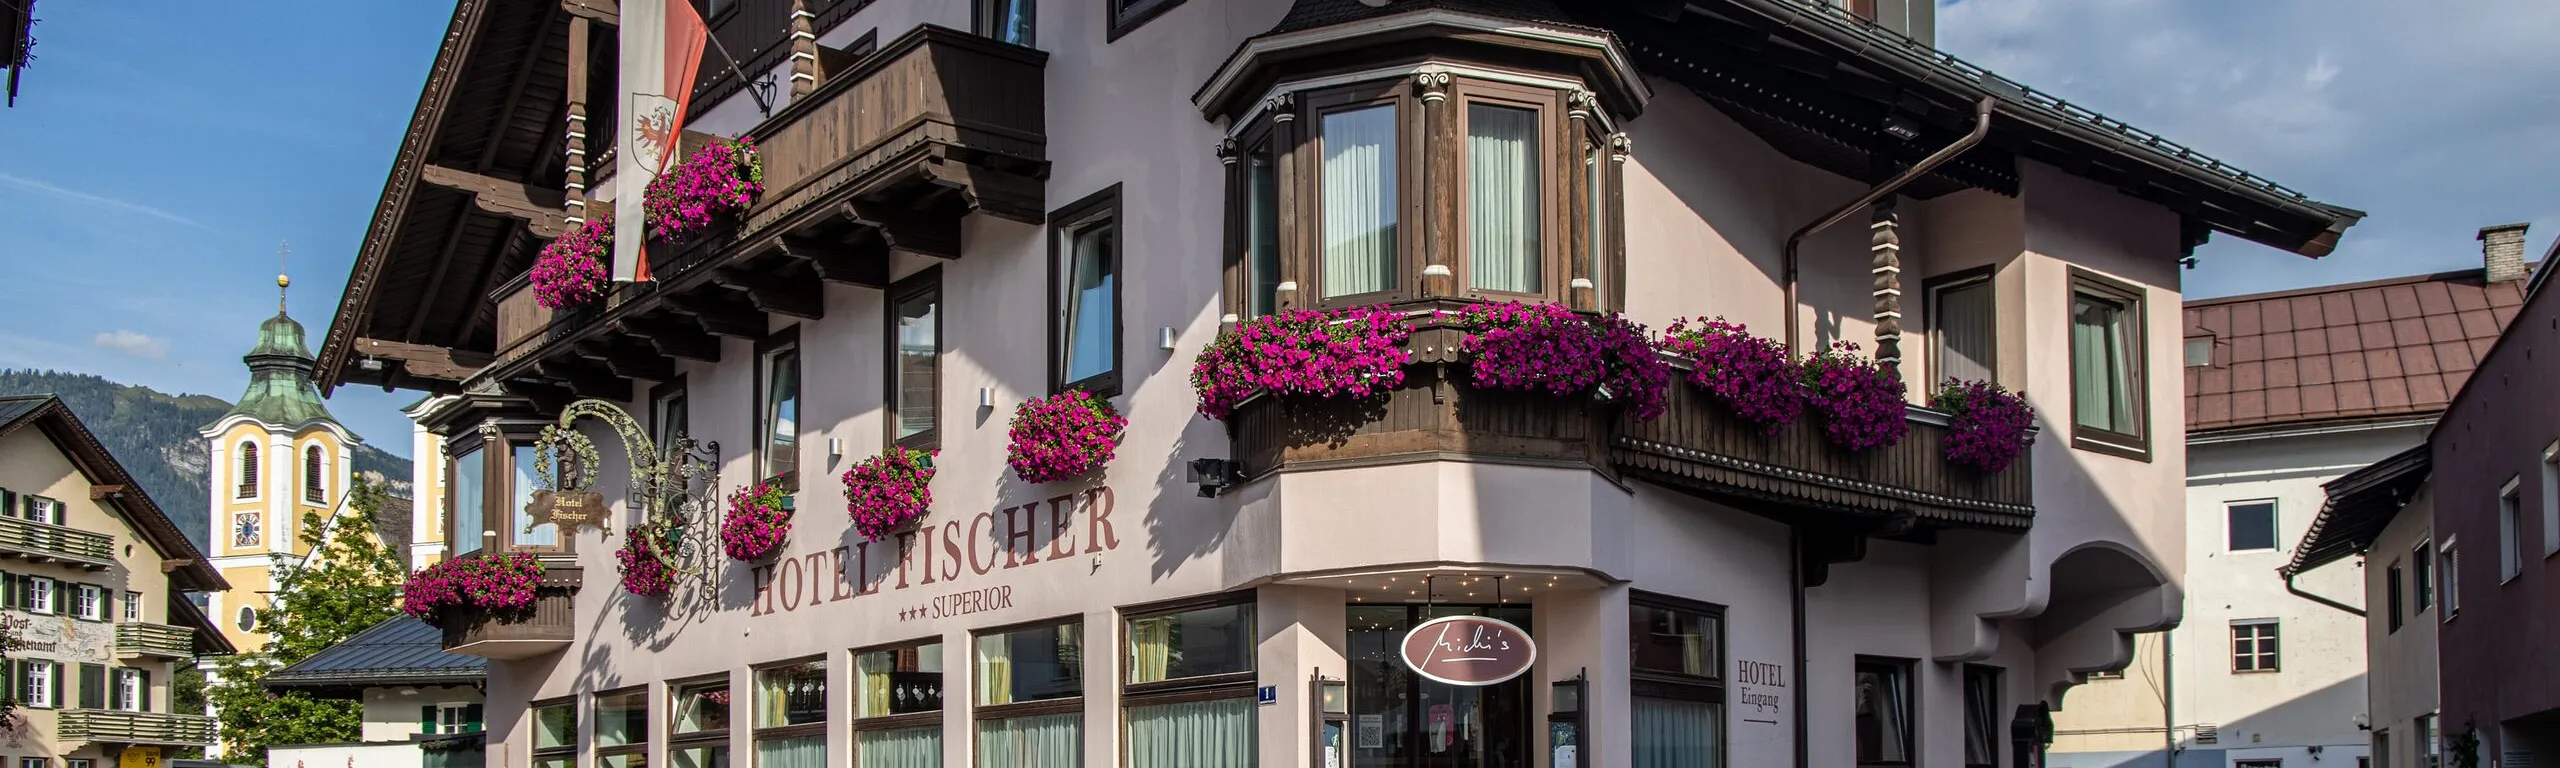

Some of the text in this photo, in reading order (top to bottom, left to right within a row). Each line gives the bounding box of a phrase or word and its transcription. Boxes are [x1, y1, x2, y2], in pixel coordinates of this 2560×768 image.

[554, 496, 582, 507] Hotel
[549, 508, 587, 522] Fischer
[751, 486, 1120, 617] HOTEL FISCHER
[932, 584, 1013, 619] SUPERIOR
[1738, 660, 1785, 687] HOTEL
[1741, 687, 1779, 713] Eingang
